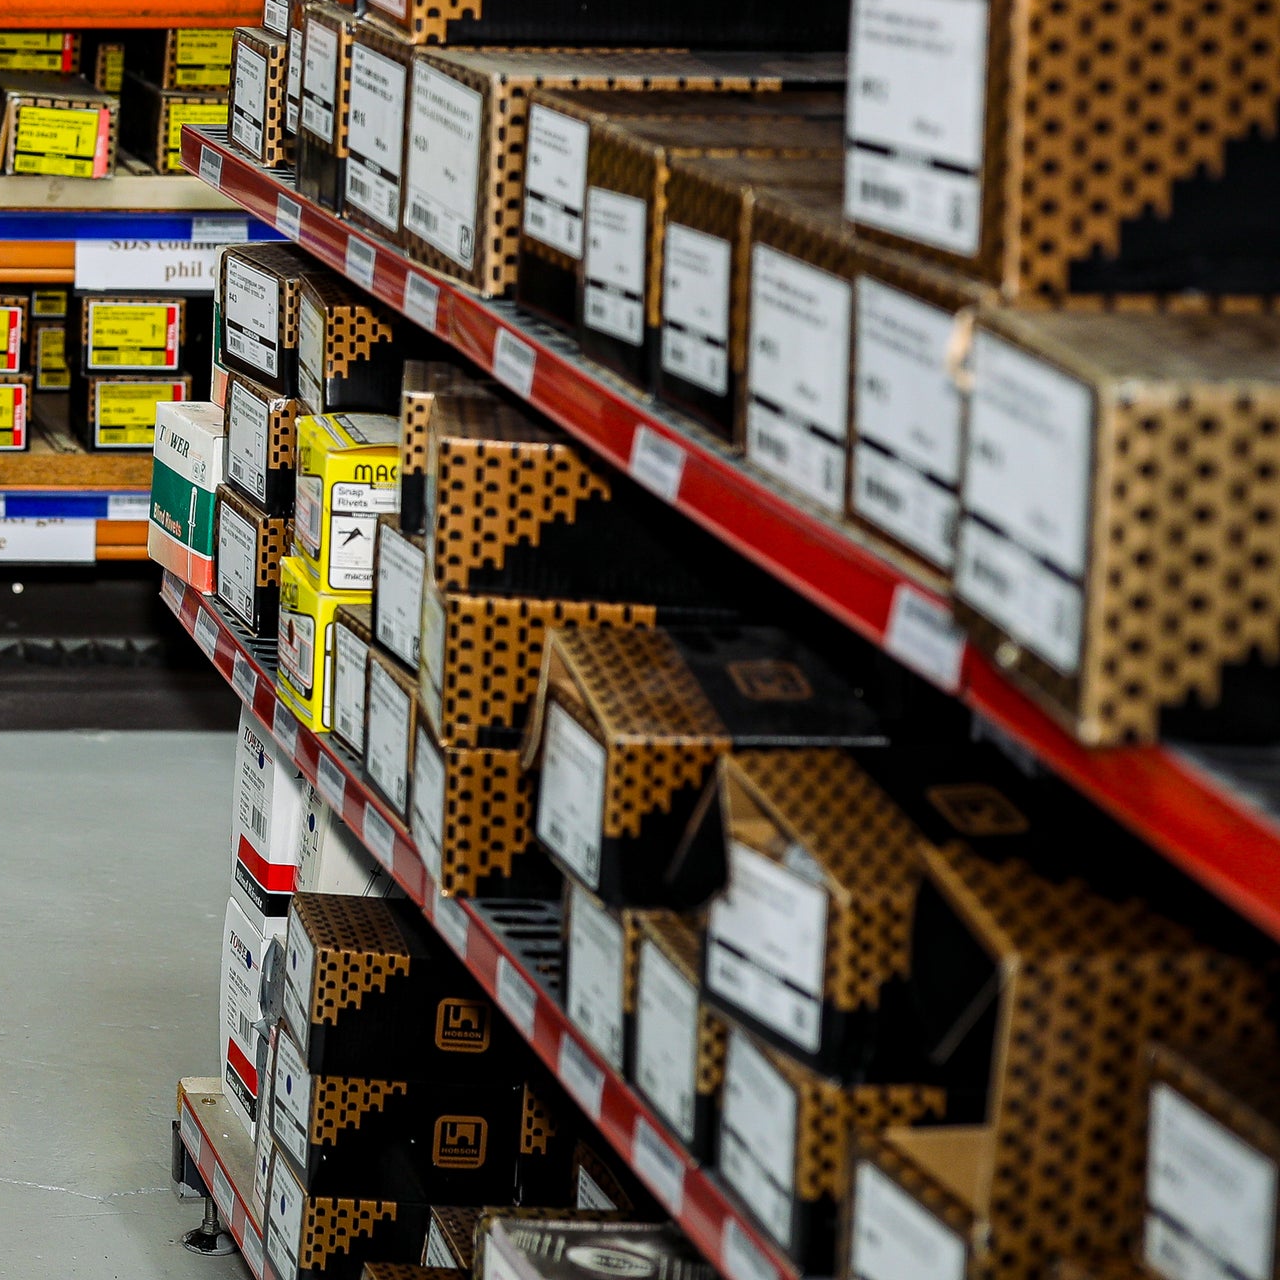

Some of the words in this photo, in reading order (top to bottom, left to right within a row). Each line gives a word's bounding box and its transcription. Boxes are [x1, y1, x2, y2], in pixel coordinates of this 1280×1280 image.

[165, 261, 202, 282] phil
[9, 327, 17, 354] METAL
[168, 323, 176, 351] METAL
[14, 406, 22, 431] METAL
[159, 424, 190, 458] TOWER
[338, 487, 364, 497] Snap
[338, 498, 368, 507] Rivets
[154, 502, 165, 524] Blind
[165, 513, 182, 538] Rivets
[235, 868, 247, 892] Blind
[248, 884, 263, 910] Rivets
[444, 1031, 481, 1039] HOBSON
[441, 1147, 477, 1155] HOBSON
